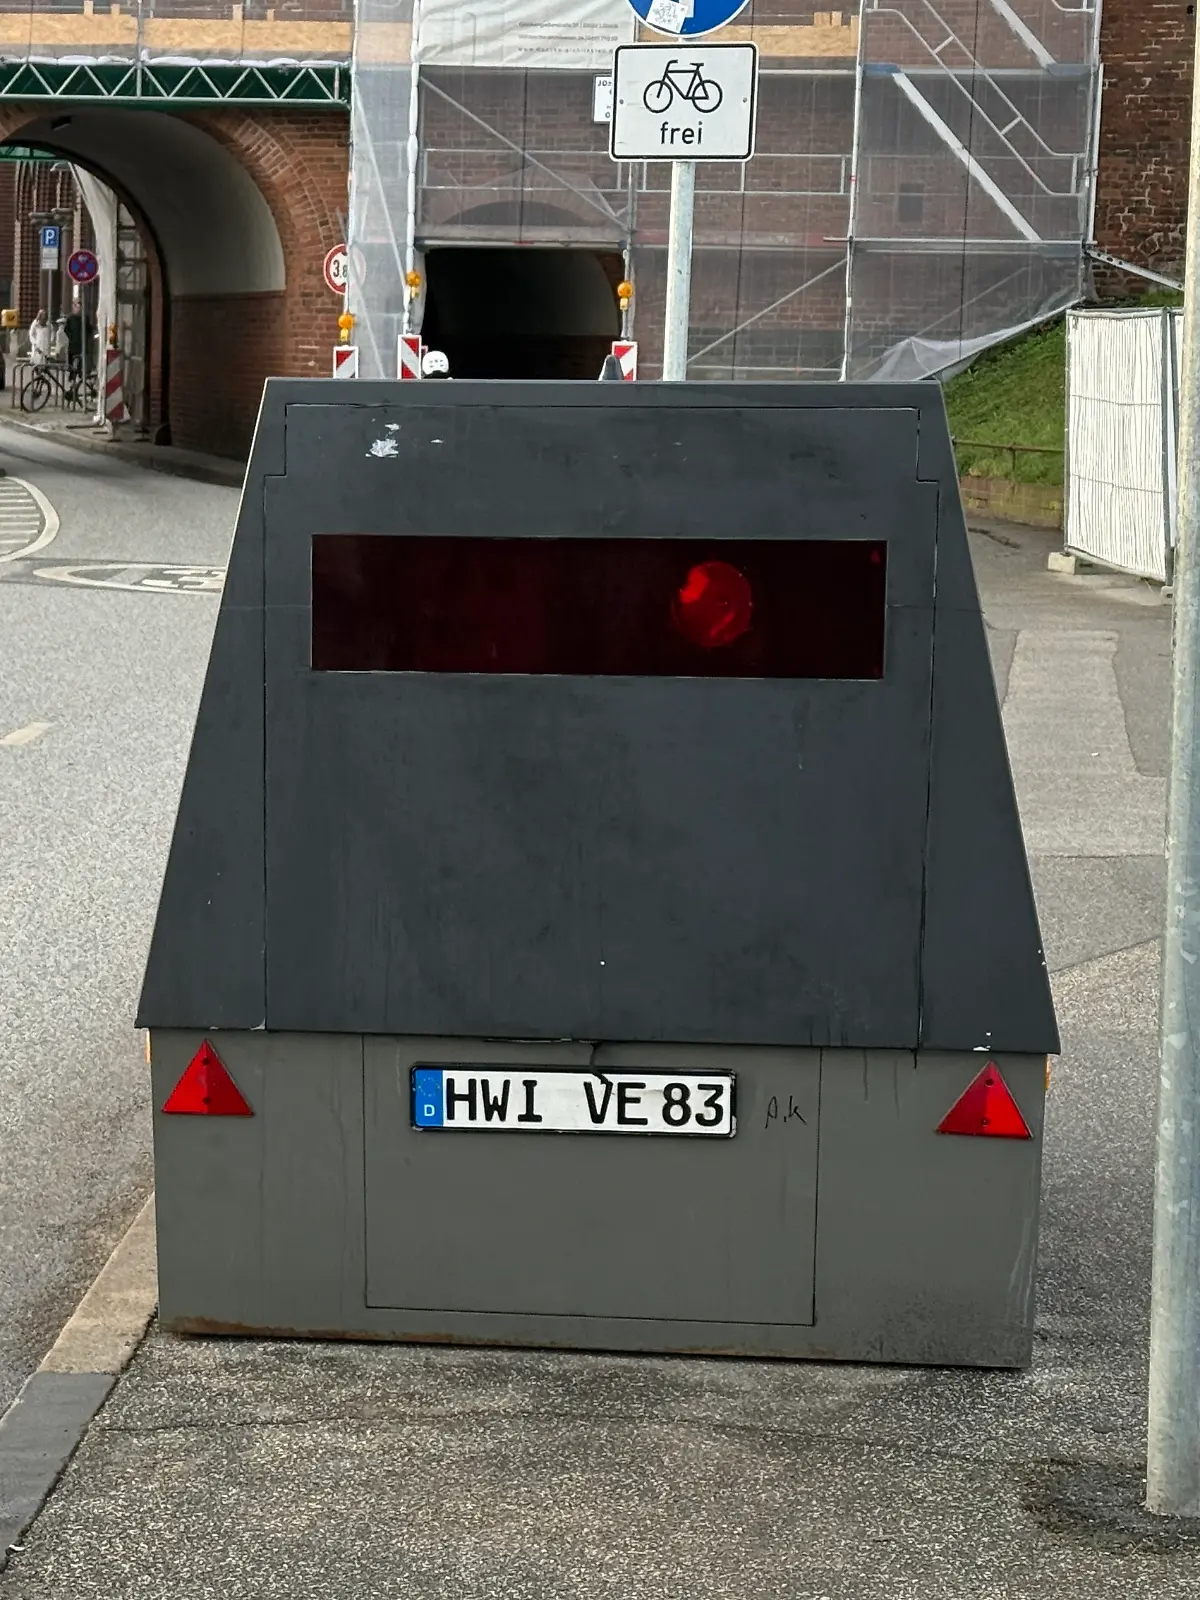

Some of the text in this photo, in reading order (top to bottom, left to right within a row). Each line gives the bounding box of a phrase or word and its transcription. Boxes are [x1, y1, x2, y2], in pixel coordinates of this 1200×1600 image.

[660, 121, 703, 145] frei
[46, 229, 55, 245] P
[424, 1104, 435, 1117] D
[446, 1078, 724, 1127] HWI VE 83
